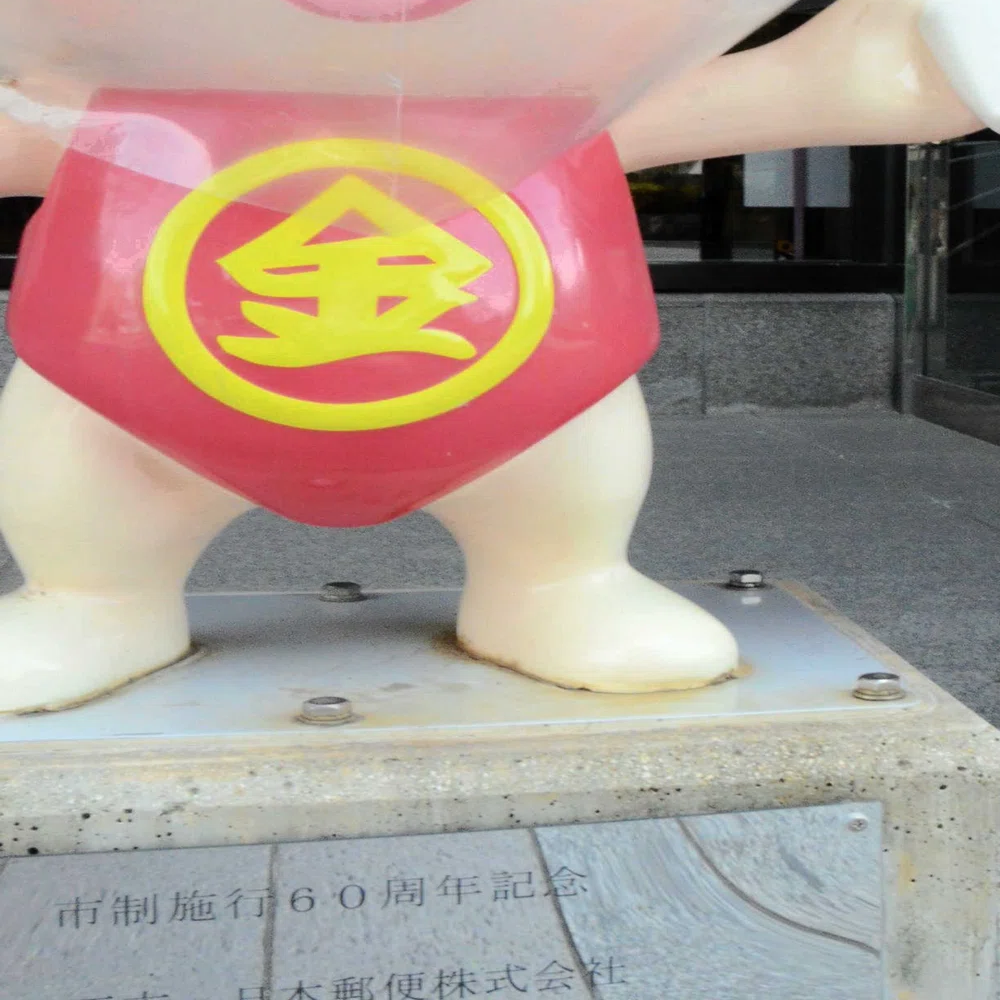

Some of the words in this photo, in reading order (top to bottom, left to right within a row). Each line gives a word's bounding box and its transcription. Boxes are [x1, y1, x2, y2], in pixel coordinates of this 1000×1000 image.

[216, 174, 493, 368] 金
[55, 865, 588, 929] 市制施行60周年記念
